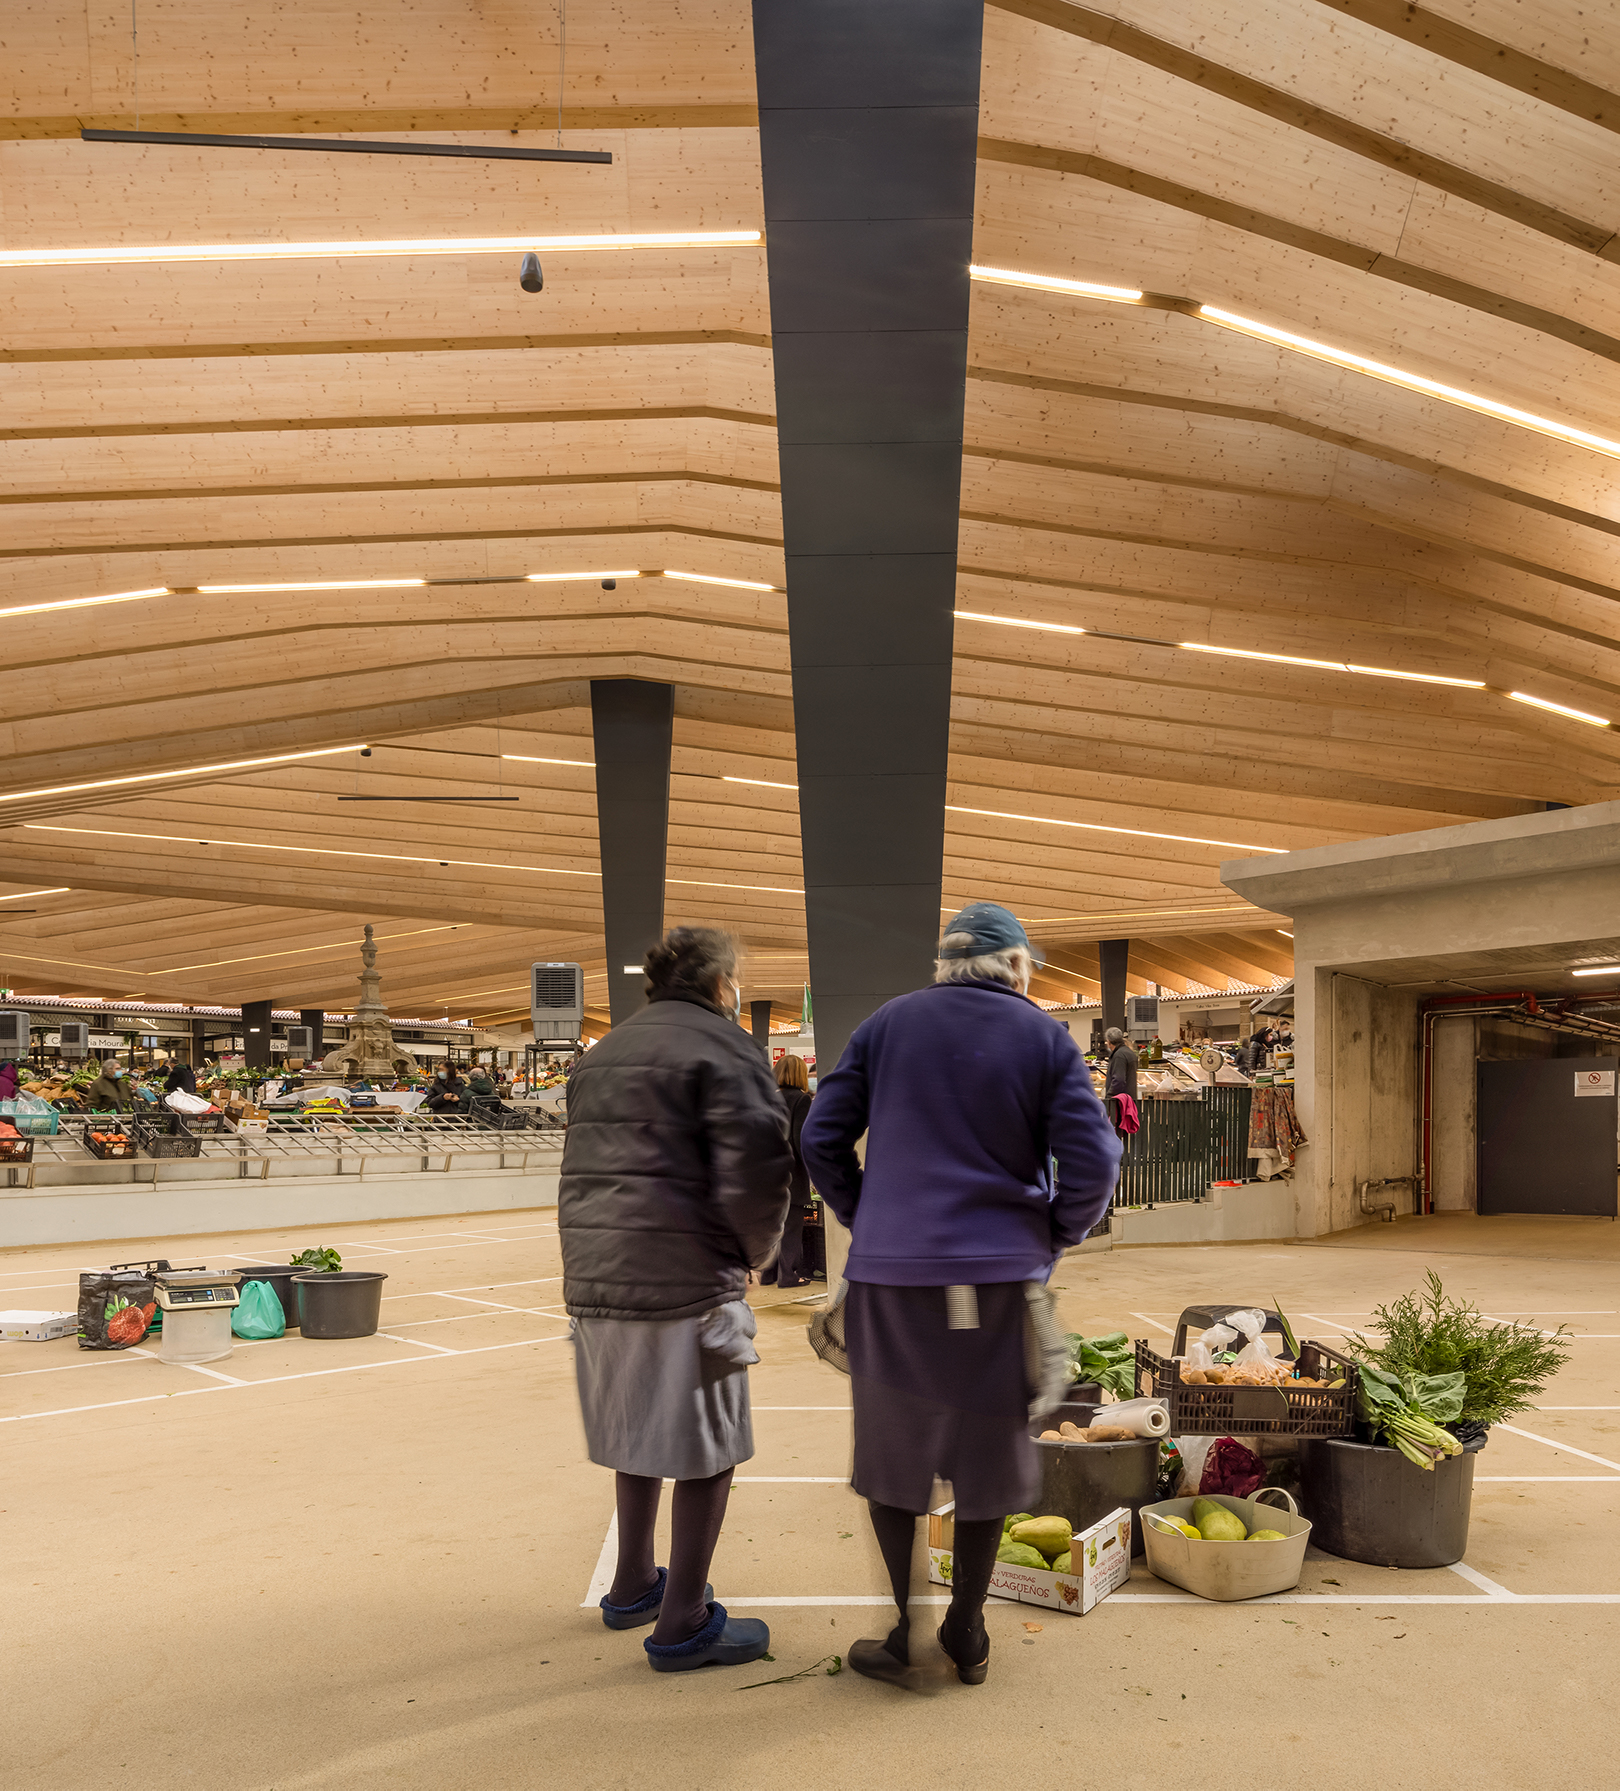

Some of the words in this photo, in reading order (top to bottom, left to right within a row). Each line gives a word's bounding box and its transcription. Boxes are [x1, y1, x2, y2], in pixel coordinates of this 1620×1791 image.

[98, 1039, 124, 1047] Moura
[270, 1042, 279, 1050] da
[1000, 1570, 1037, 1584] VERDURAS
[988, 1578, 1050, 1598] ALAGUEÑOS
